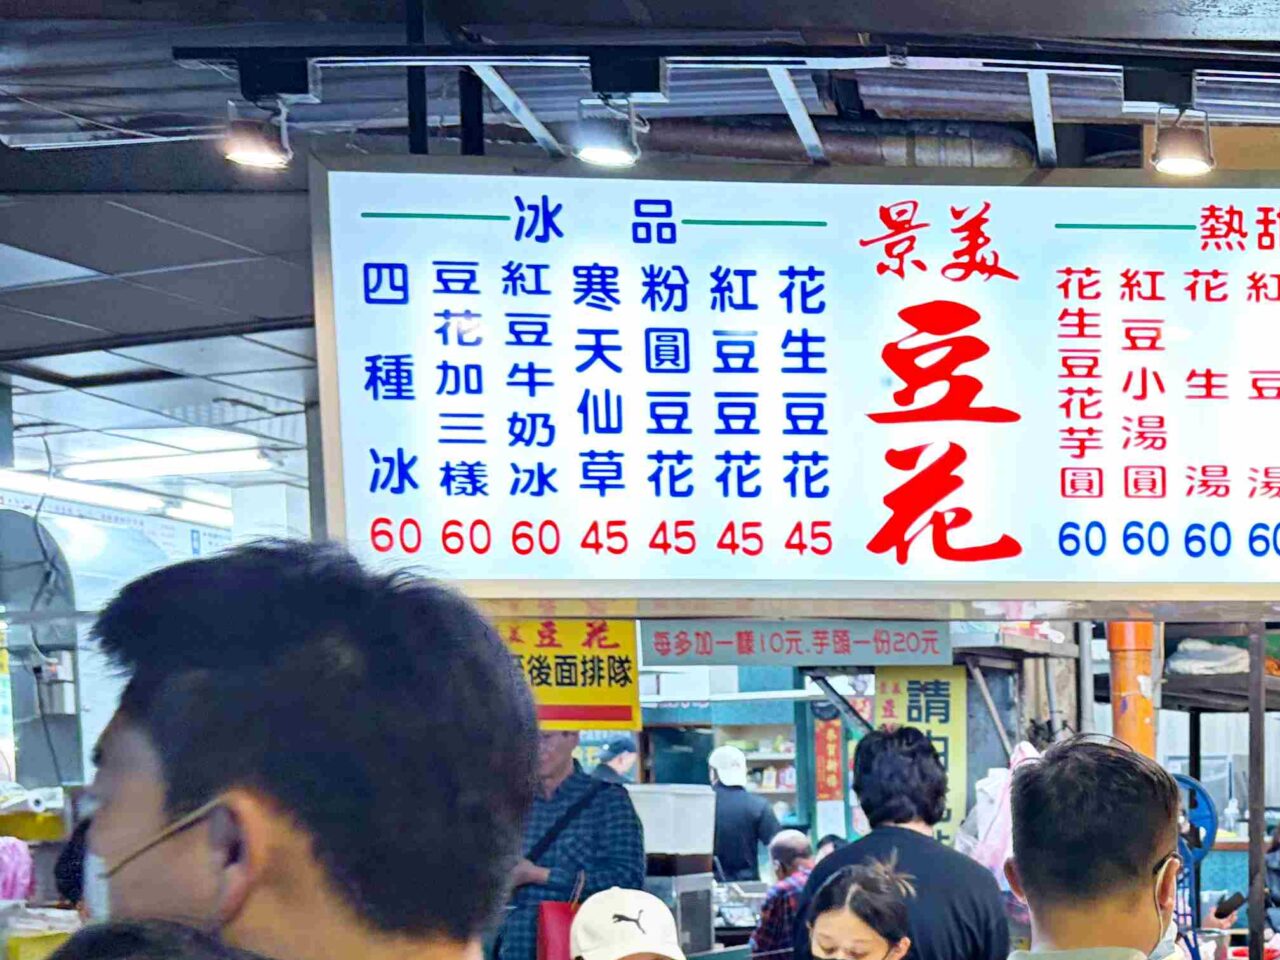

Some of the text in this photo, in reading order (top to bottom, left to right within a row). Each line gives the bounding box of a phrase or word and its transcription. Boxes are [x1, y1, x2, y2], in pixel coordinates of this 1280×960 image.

[514, 196, 678, 245] 冰品
[860, 200, 1019, 283] 景美
[363, 262, 419, 495] 四種冰
[432, 261, 489, 498] 豆花加三樣
[502, 261, 558, 498] 紅豆牛奶冰
[573, 263, 626, 498] 寒天仙草
[641, 265, 695, 499] 粉圓豆花
[710, 266, 762, 499] 紅豆豆花
[779, 266, 831, 499] 花生豆花
[1056, 267, 1104, 499] 花生豆花芋圓
[1120, 268, 1168, 500] 紅豆小湯圓
[1183, 269, 1232, 500] 花生湯
[865, 300, 1022, 566] 豆花
[370, 518, 423, 554] 60
[441, 519, 492, 555] 60
[511, 520, 561, 556] 60
[580, 520, 629, 556] 45
[648, 521, 697, 556] 45
[717, 521, 765, 557] 45
[785, 521, 833, 557] 45
[1058, 521, 1107, 557] 60
[1122, 522, 1169, 557] 60
[1184, 522, 1232, 558] 60
[535, 619, 620, 649] 豆花
